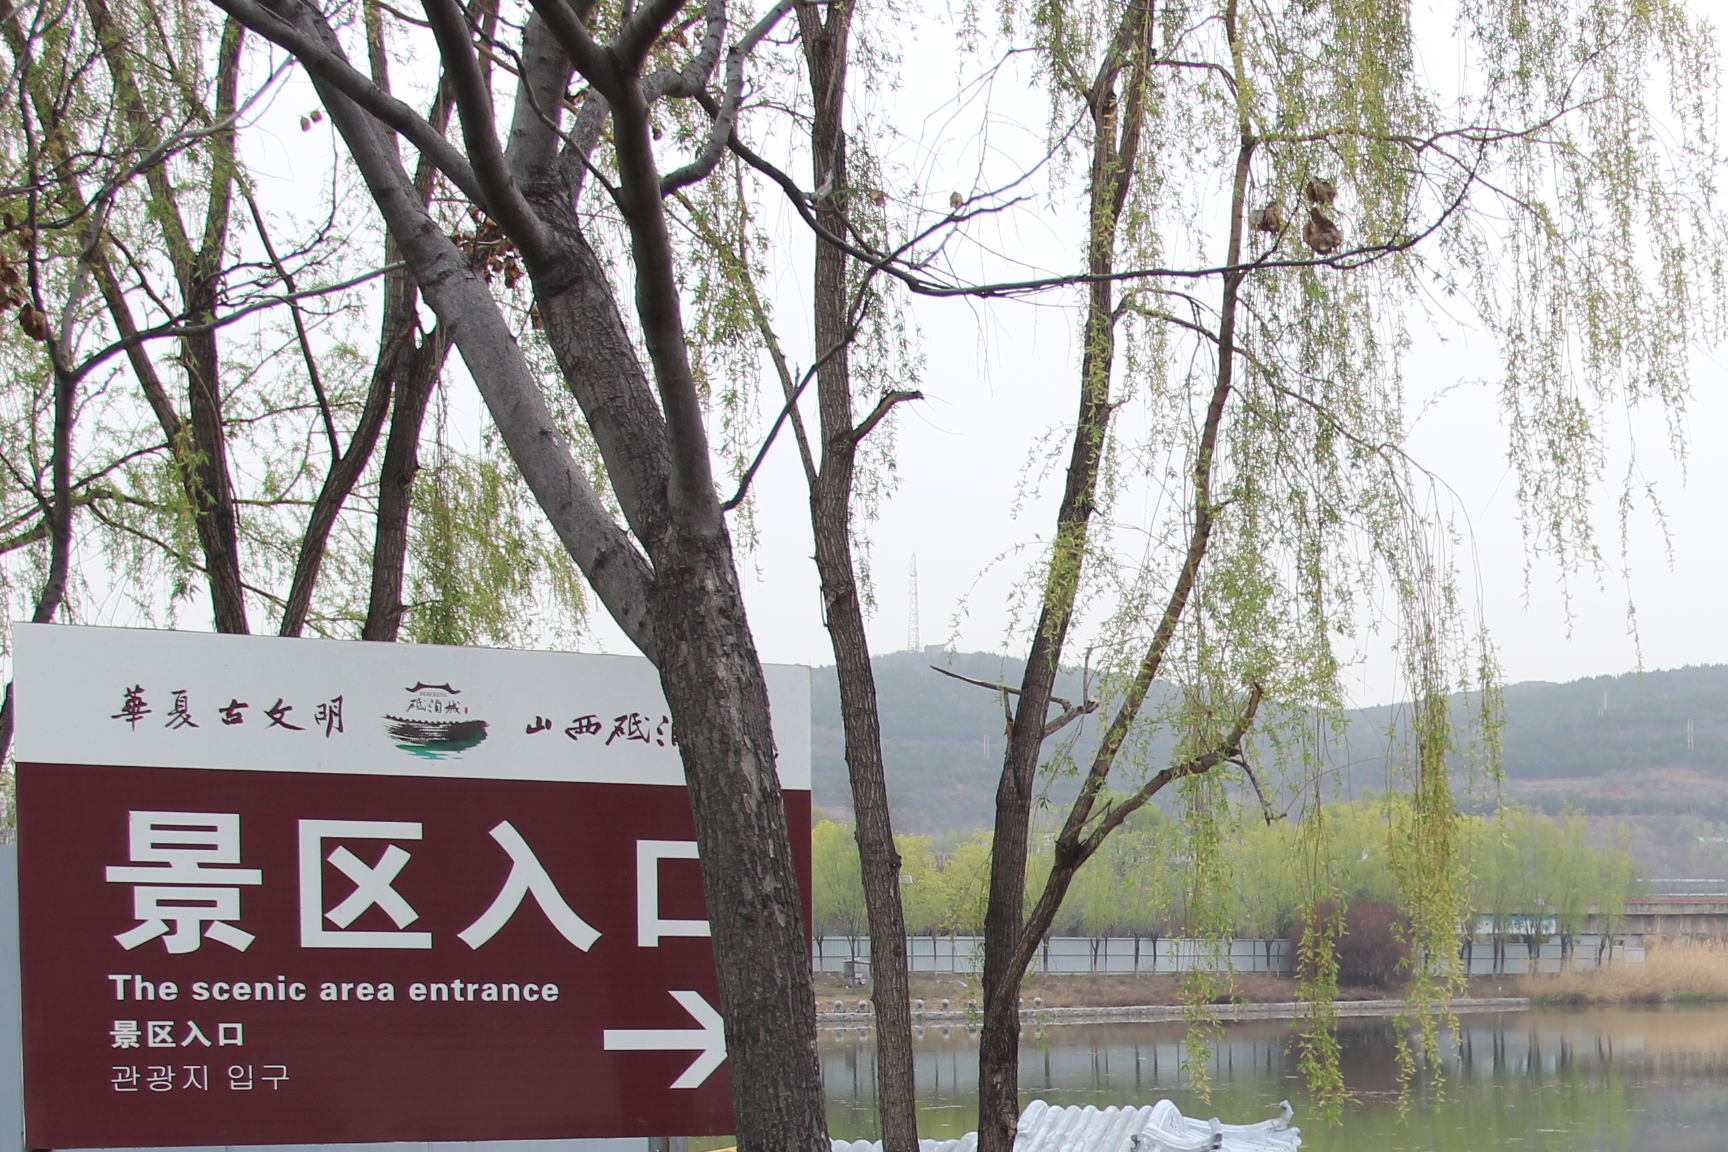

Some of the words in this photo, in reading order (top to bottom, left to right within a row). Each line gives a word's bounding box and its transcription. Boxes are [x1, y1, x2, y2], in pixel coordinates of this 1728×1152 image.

[106, 810, 711, 955] 景区入口
[109, 974, 179, 1001] The
[191, 975, 307, 1001] scenic
[319, 980, 395, 1001] area
[409, 978, 560, 1001] entrance
[109, 1020, 244, 1049] 景区入口
[110, 1064, 209, 1092] 관광지
[228, 1064, 290, 1091] 입구
